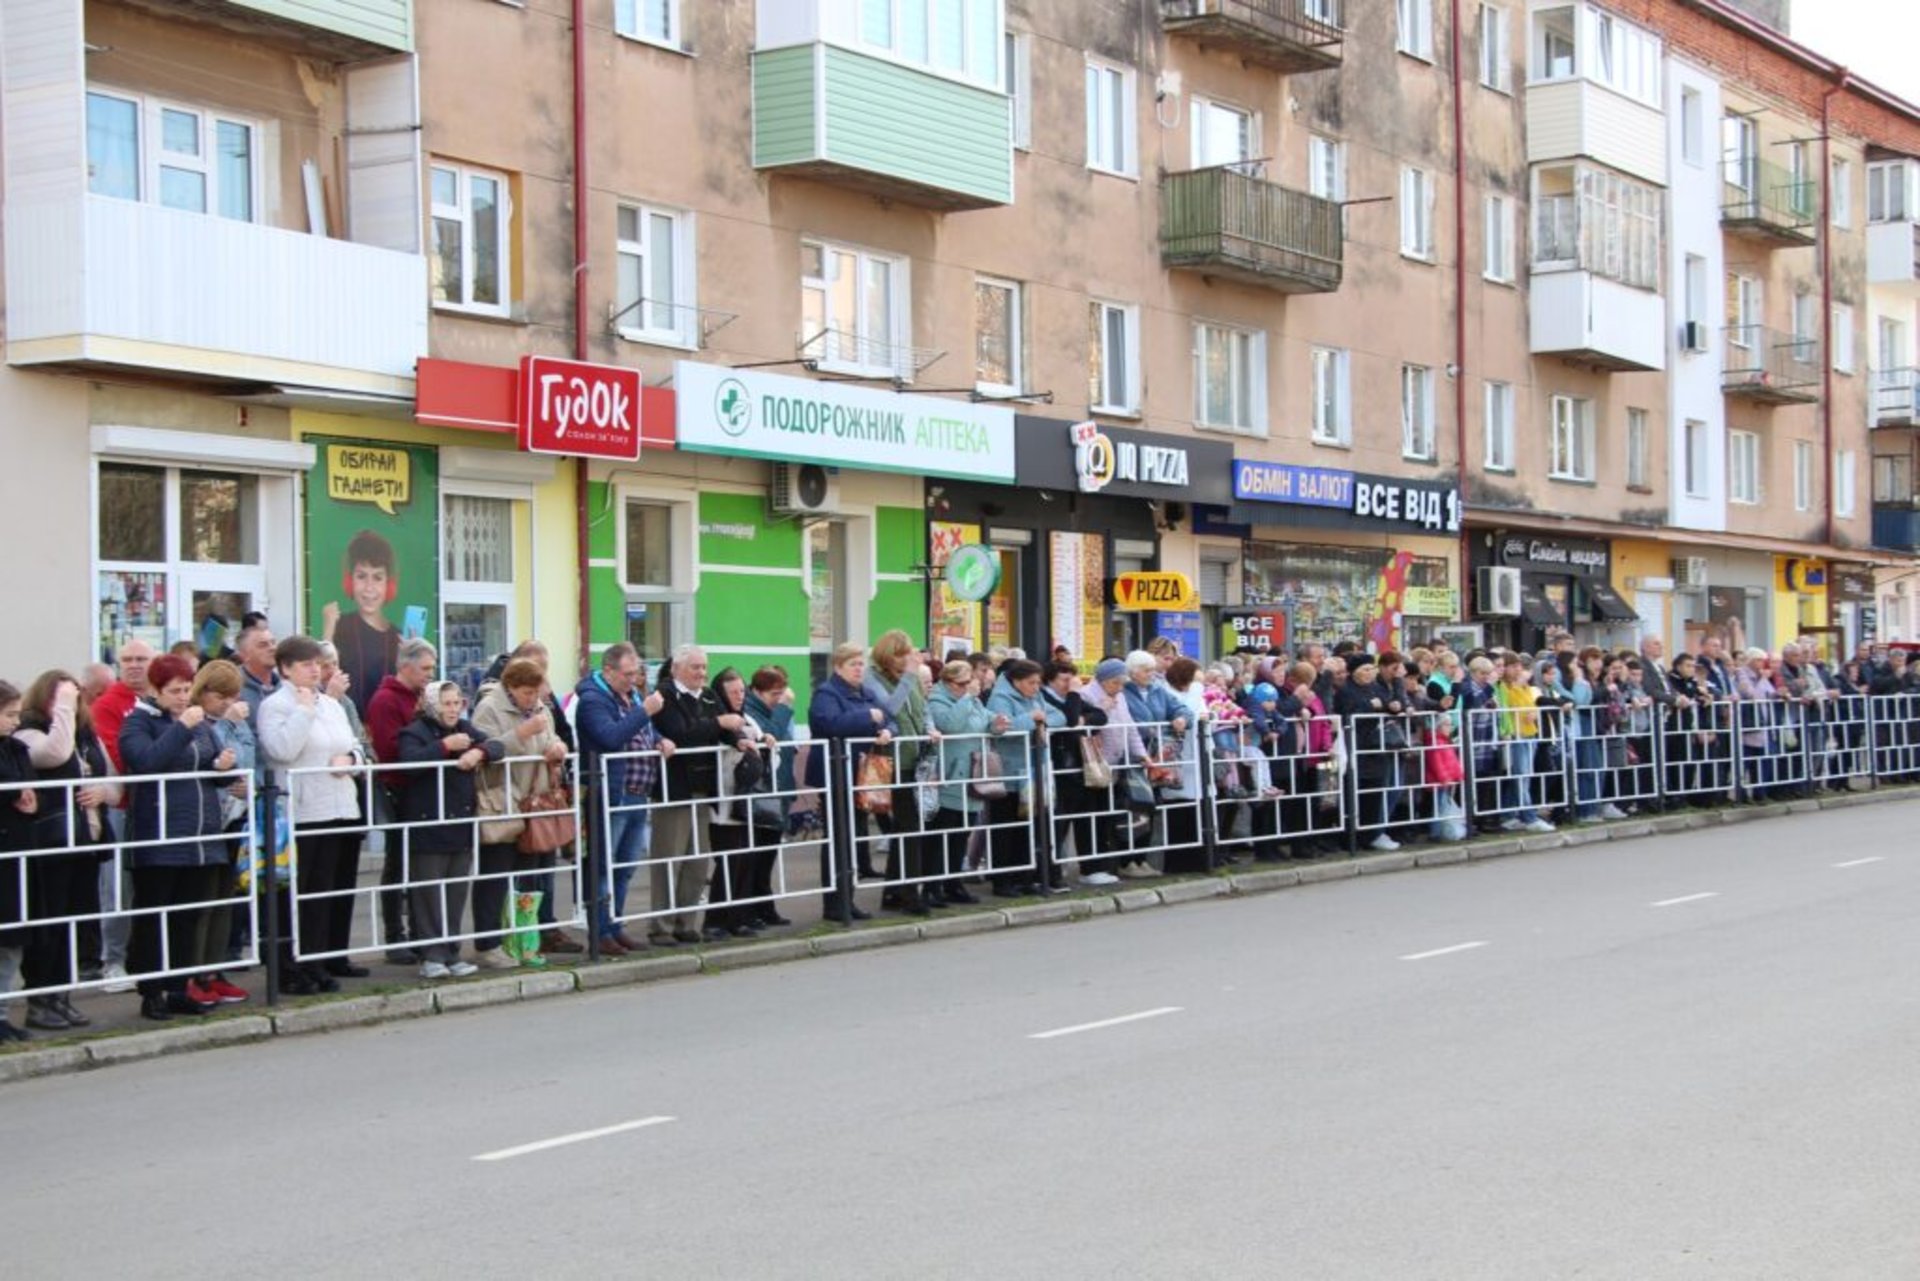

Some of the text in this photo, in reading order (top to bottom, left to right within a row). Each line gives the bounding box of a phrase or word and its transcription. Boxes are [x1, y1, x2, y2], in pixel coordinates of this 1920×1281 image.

[762, 395, 991, 454] ПОДОРОЖНИК АПТЕКА
[340, 449, 397, 472] ОБИРАЙ
[1139, 445, 1190, 487] PIZZA
[333, 474, 404, 498] ГАДЖЕТИ
[1240, 466, 1350, 501] ОБМІН ВАЛЮТ
[1355, 482, 1400, 519] ВСЕ
[1405, 488, 1442, 530] ВІД
[1446, 488, 1459, 531] 1
[1136, 578, 1181, 601] PIZZA
[1232, 616, 1274, 631] ВСЕ
[1236, 634, 1272, 651] ВІД
